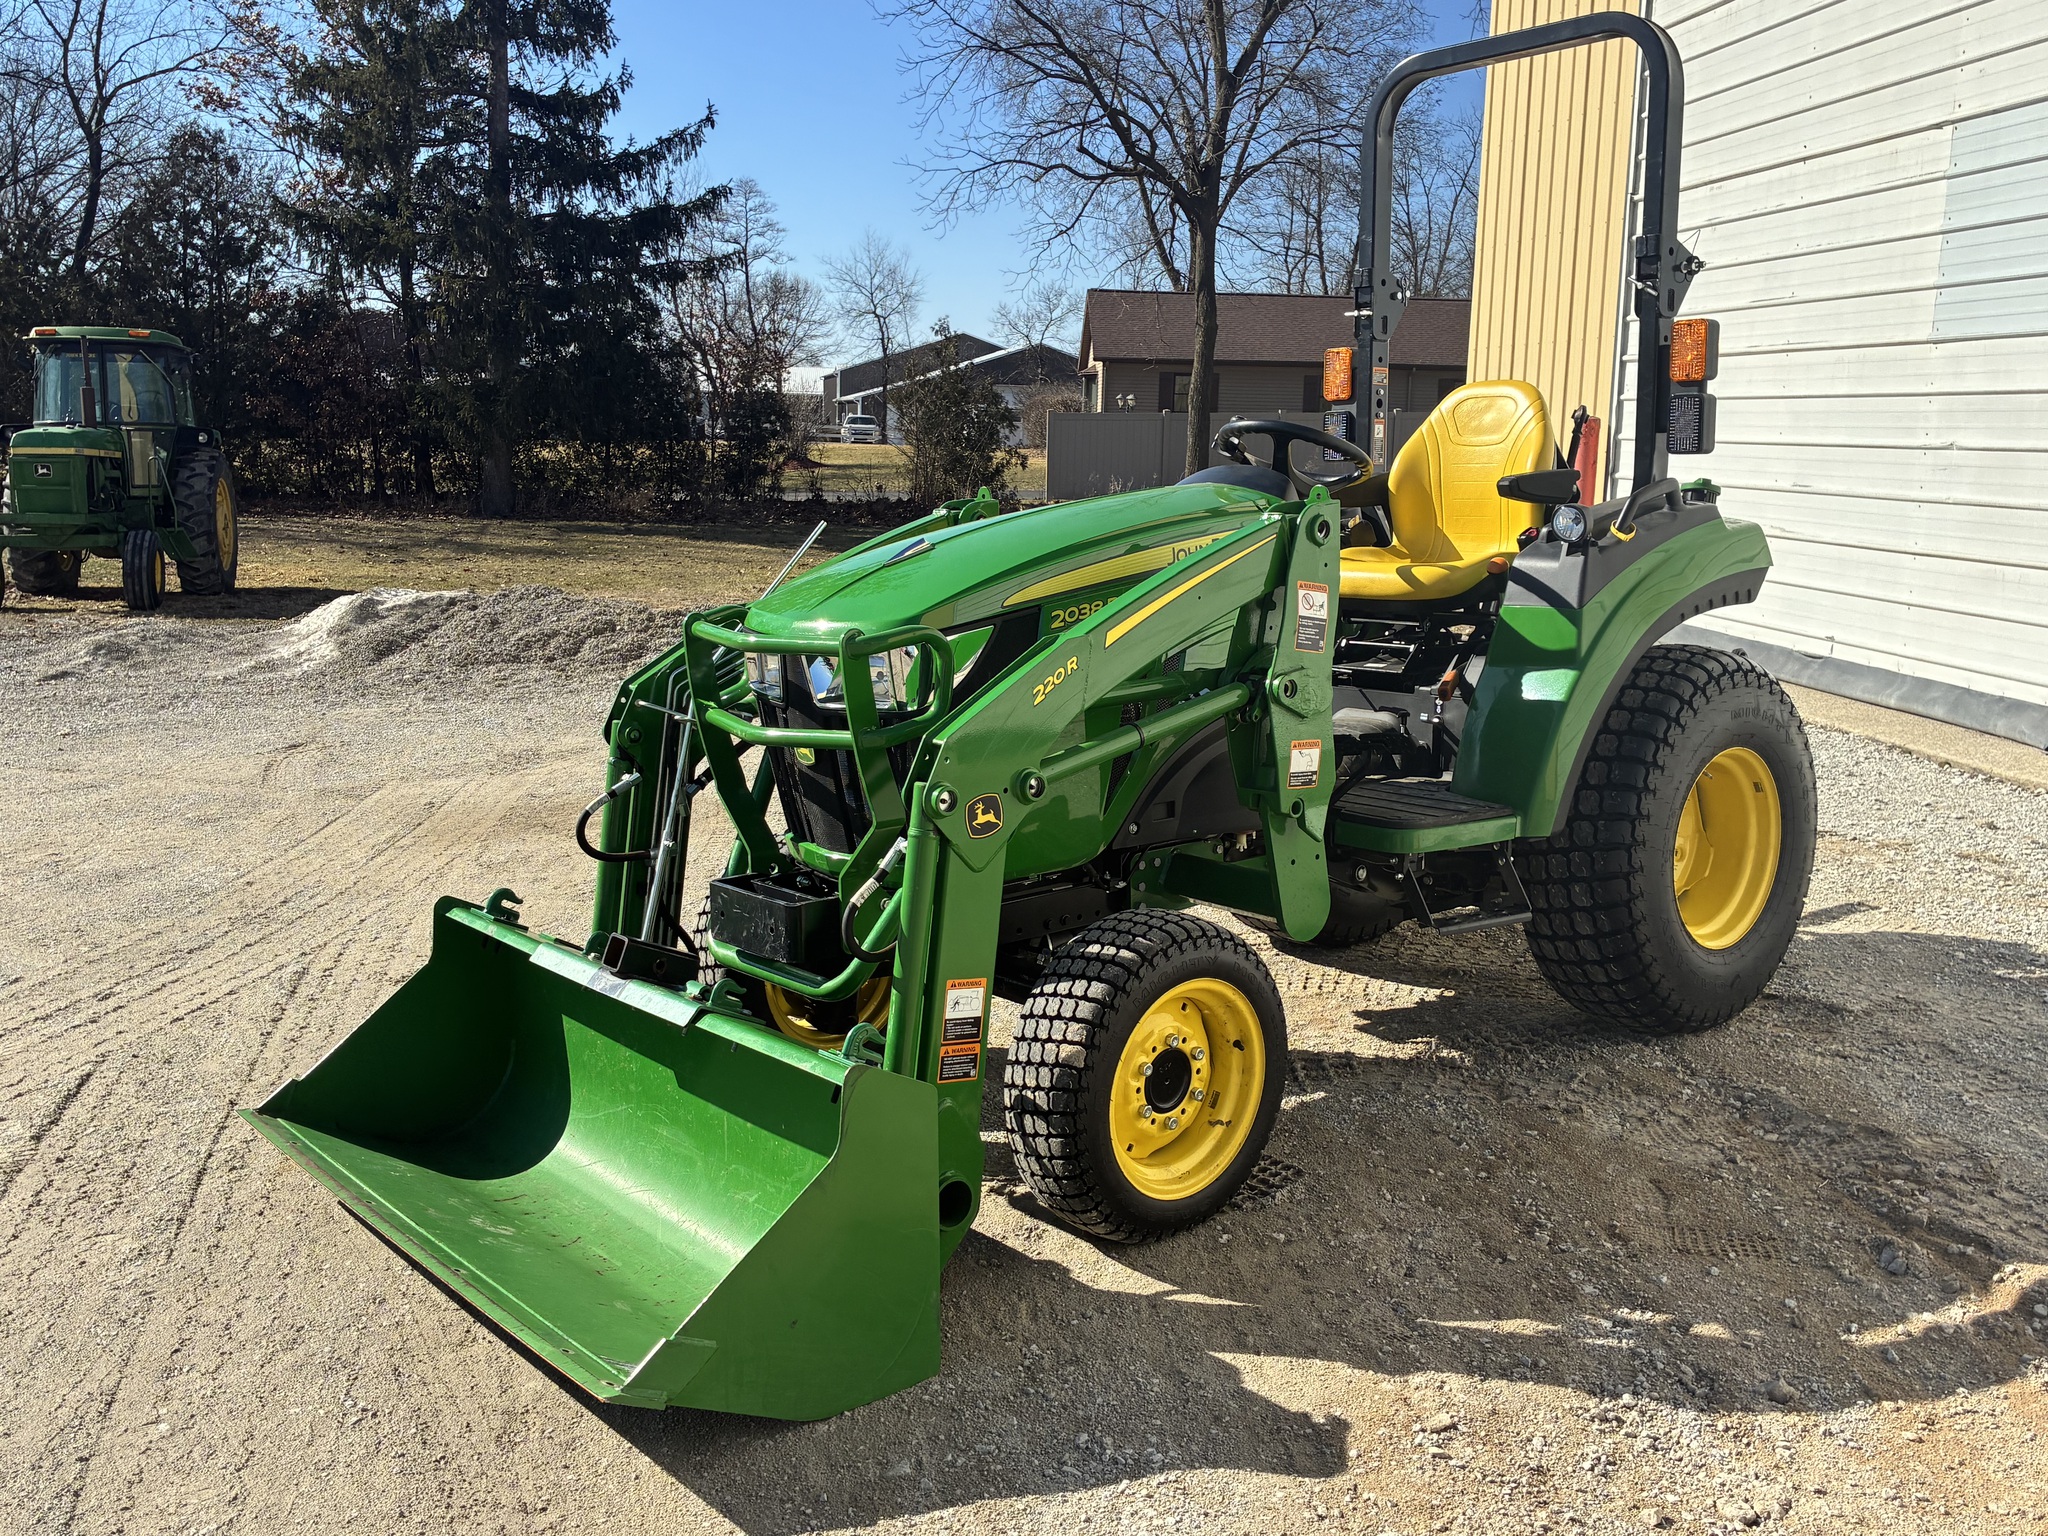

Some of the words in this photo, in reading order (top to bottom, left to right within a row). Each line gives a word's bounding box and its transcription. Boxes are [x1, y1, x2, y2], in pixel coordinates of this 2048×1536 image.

[1166, 543, 1209, 566] JOH
[1050, 596, 1118, 629] 2038
[957, 980, 982, 988] WARNING
[951, 1046, 976, 1054] WARNING
